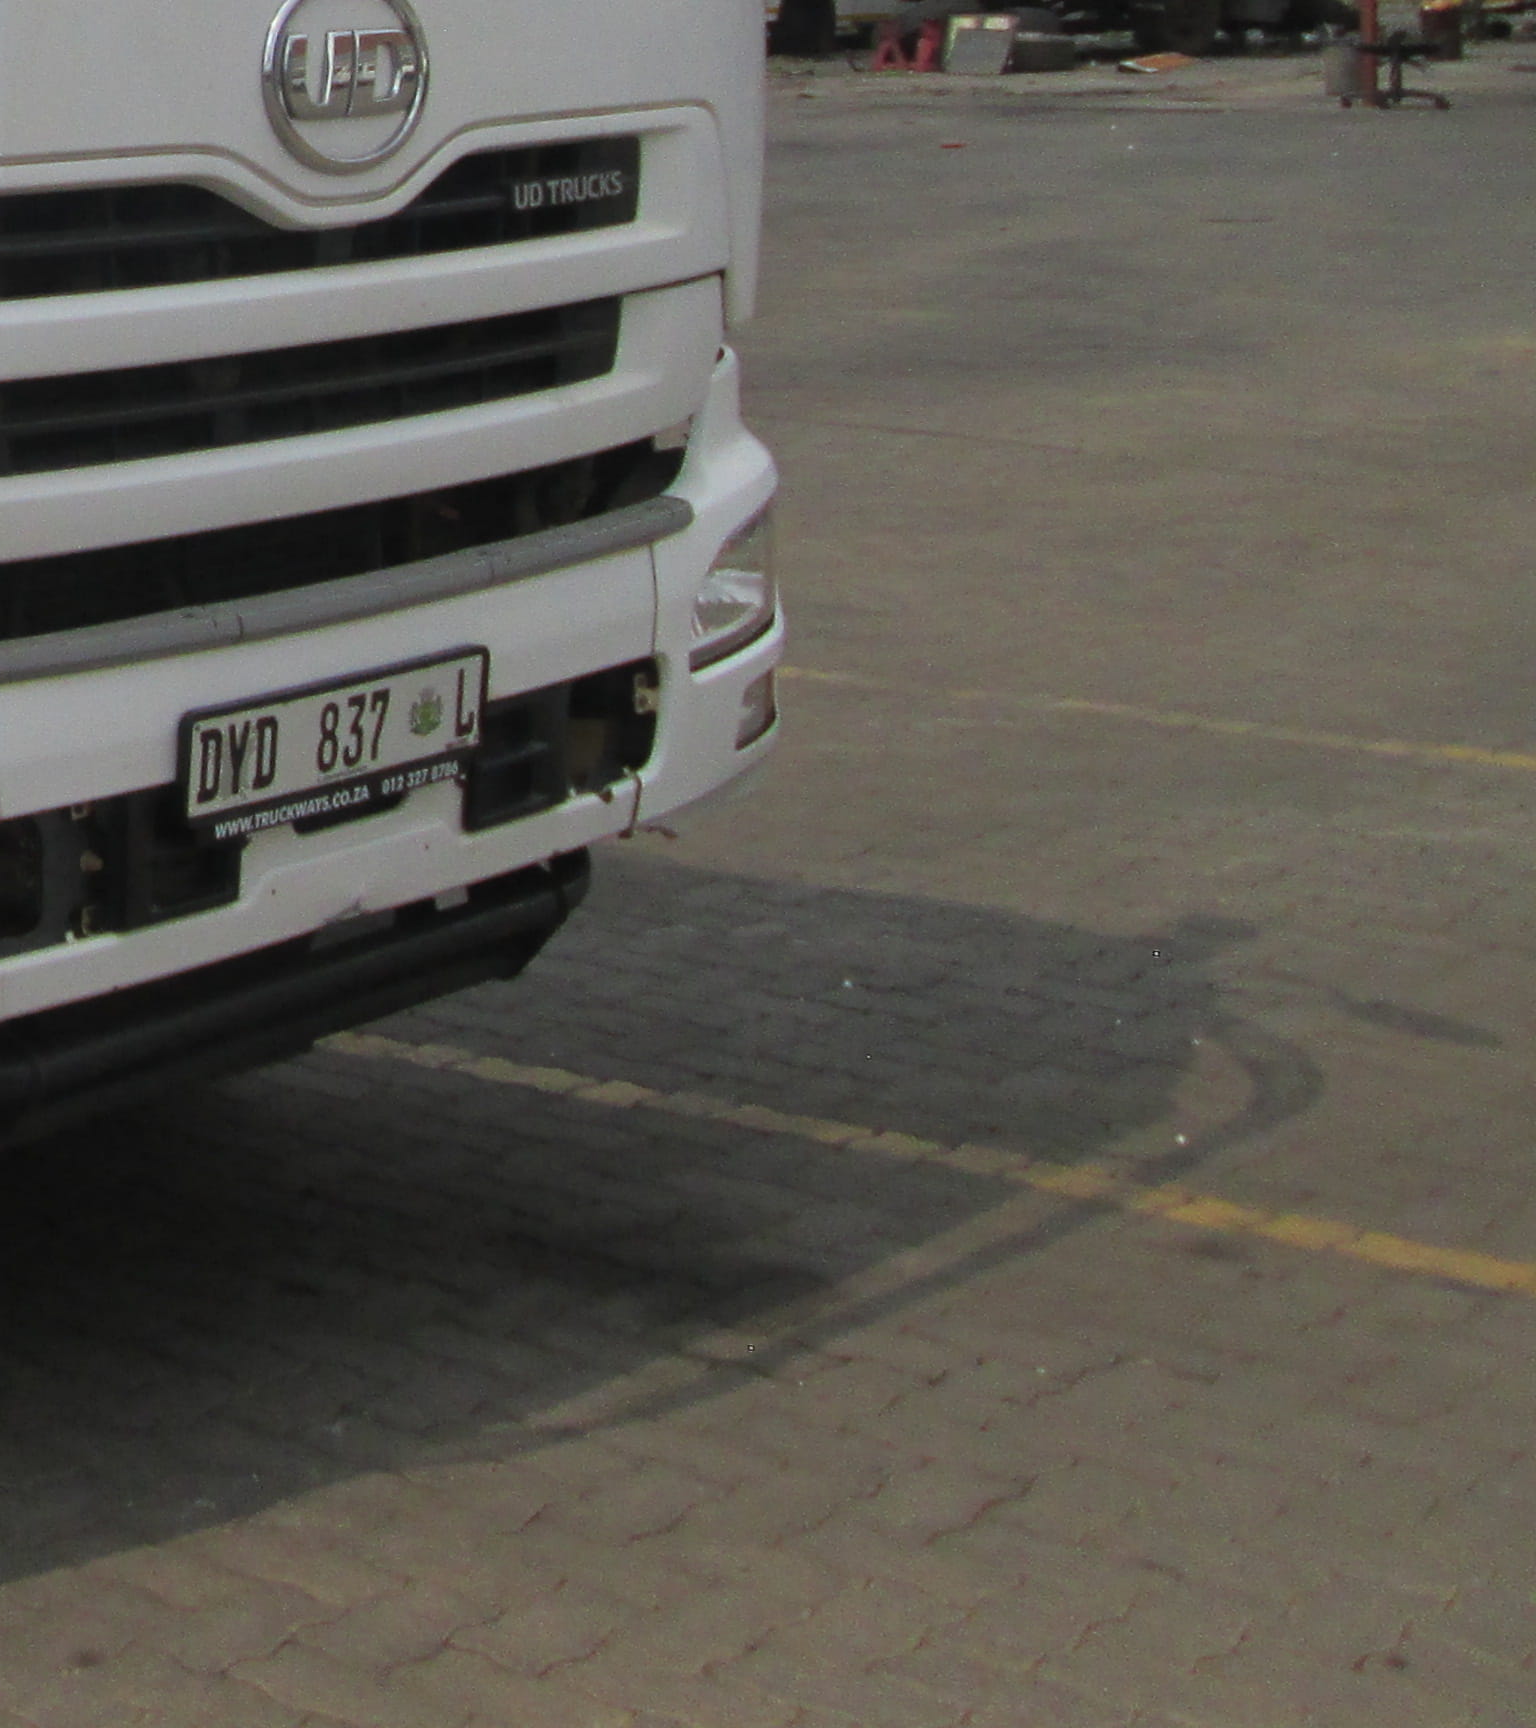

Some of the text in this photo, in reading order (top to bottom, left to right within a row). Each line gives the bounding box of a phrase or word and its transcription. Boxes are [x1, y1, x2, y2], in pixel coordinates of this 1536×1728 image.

[513, 170, 625, 210] UD TRUCKS
[197, 667, 476, 803] DYD 837 L
[214, 784, 371, 840] WWW.TRUCKWAYS.CO.ZA
